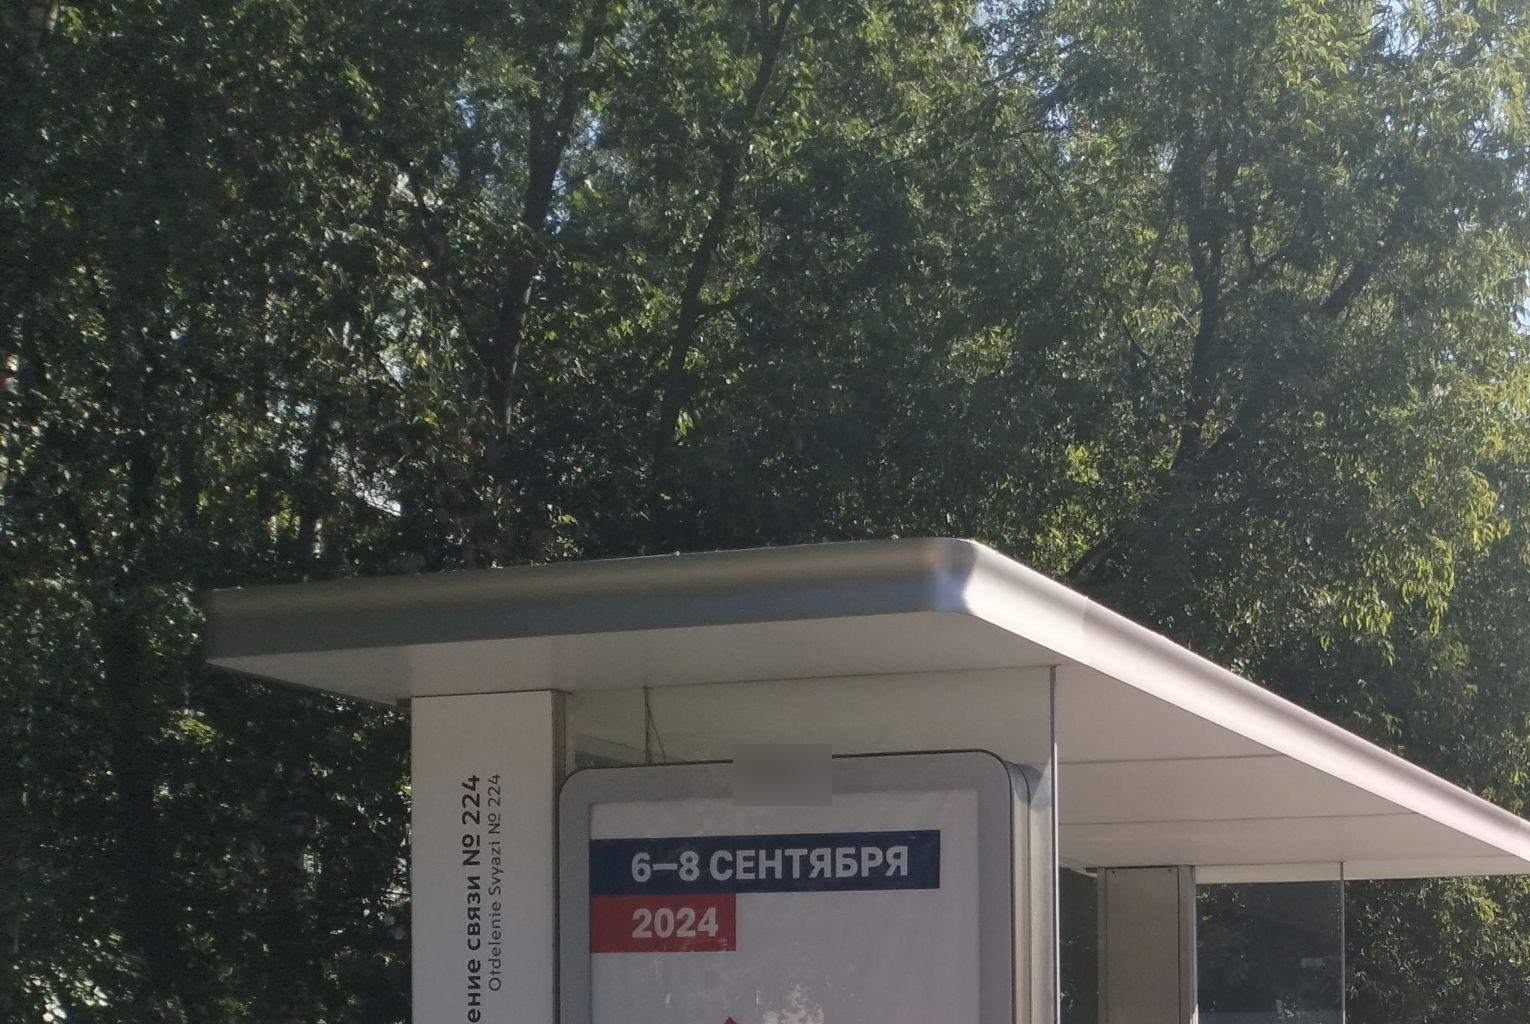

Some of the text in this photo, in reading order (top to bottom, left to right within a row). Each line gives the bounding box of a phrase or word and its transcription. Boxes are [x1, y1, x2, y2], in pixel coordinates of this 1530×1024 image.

[462, 774, 481, 825] 224
[488, 774, 501, 807] 224
[488, 841, 505, 895] Svyazi
[709, 846, 909, 881] СЕНТЯБРЯ
[466, 876, 481, 951] связи
[631, 907, 719, 938] 2024
[487, 901, 502, 991] Otdelenie
